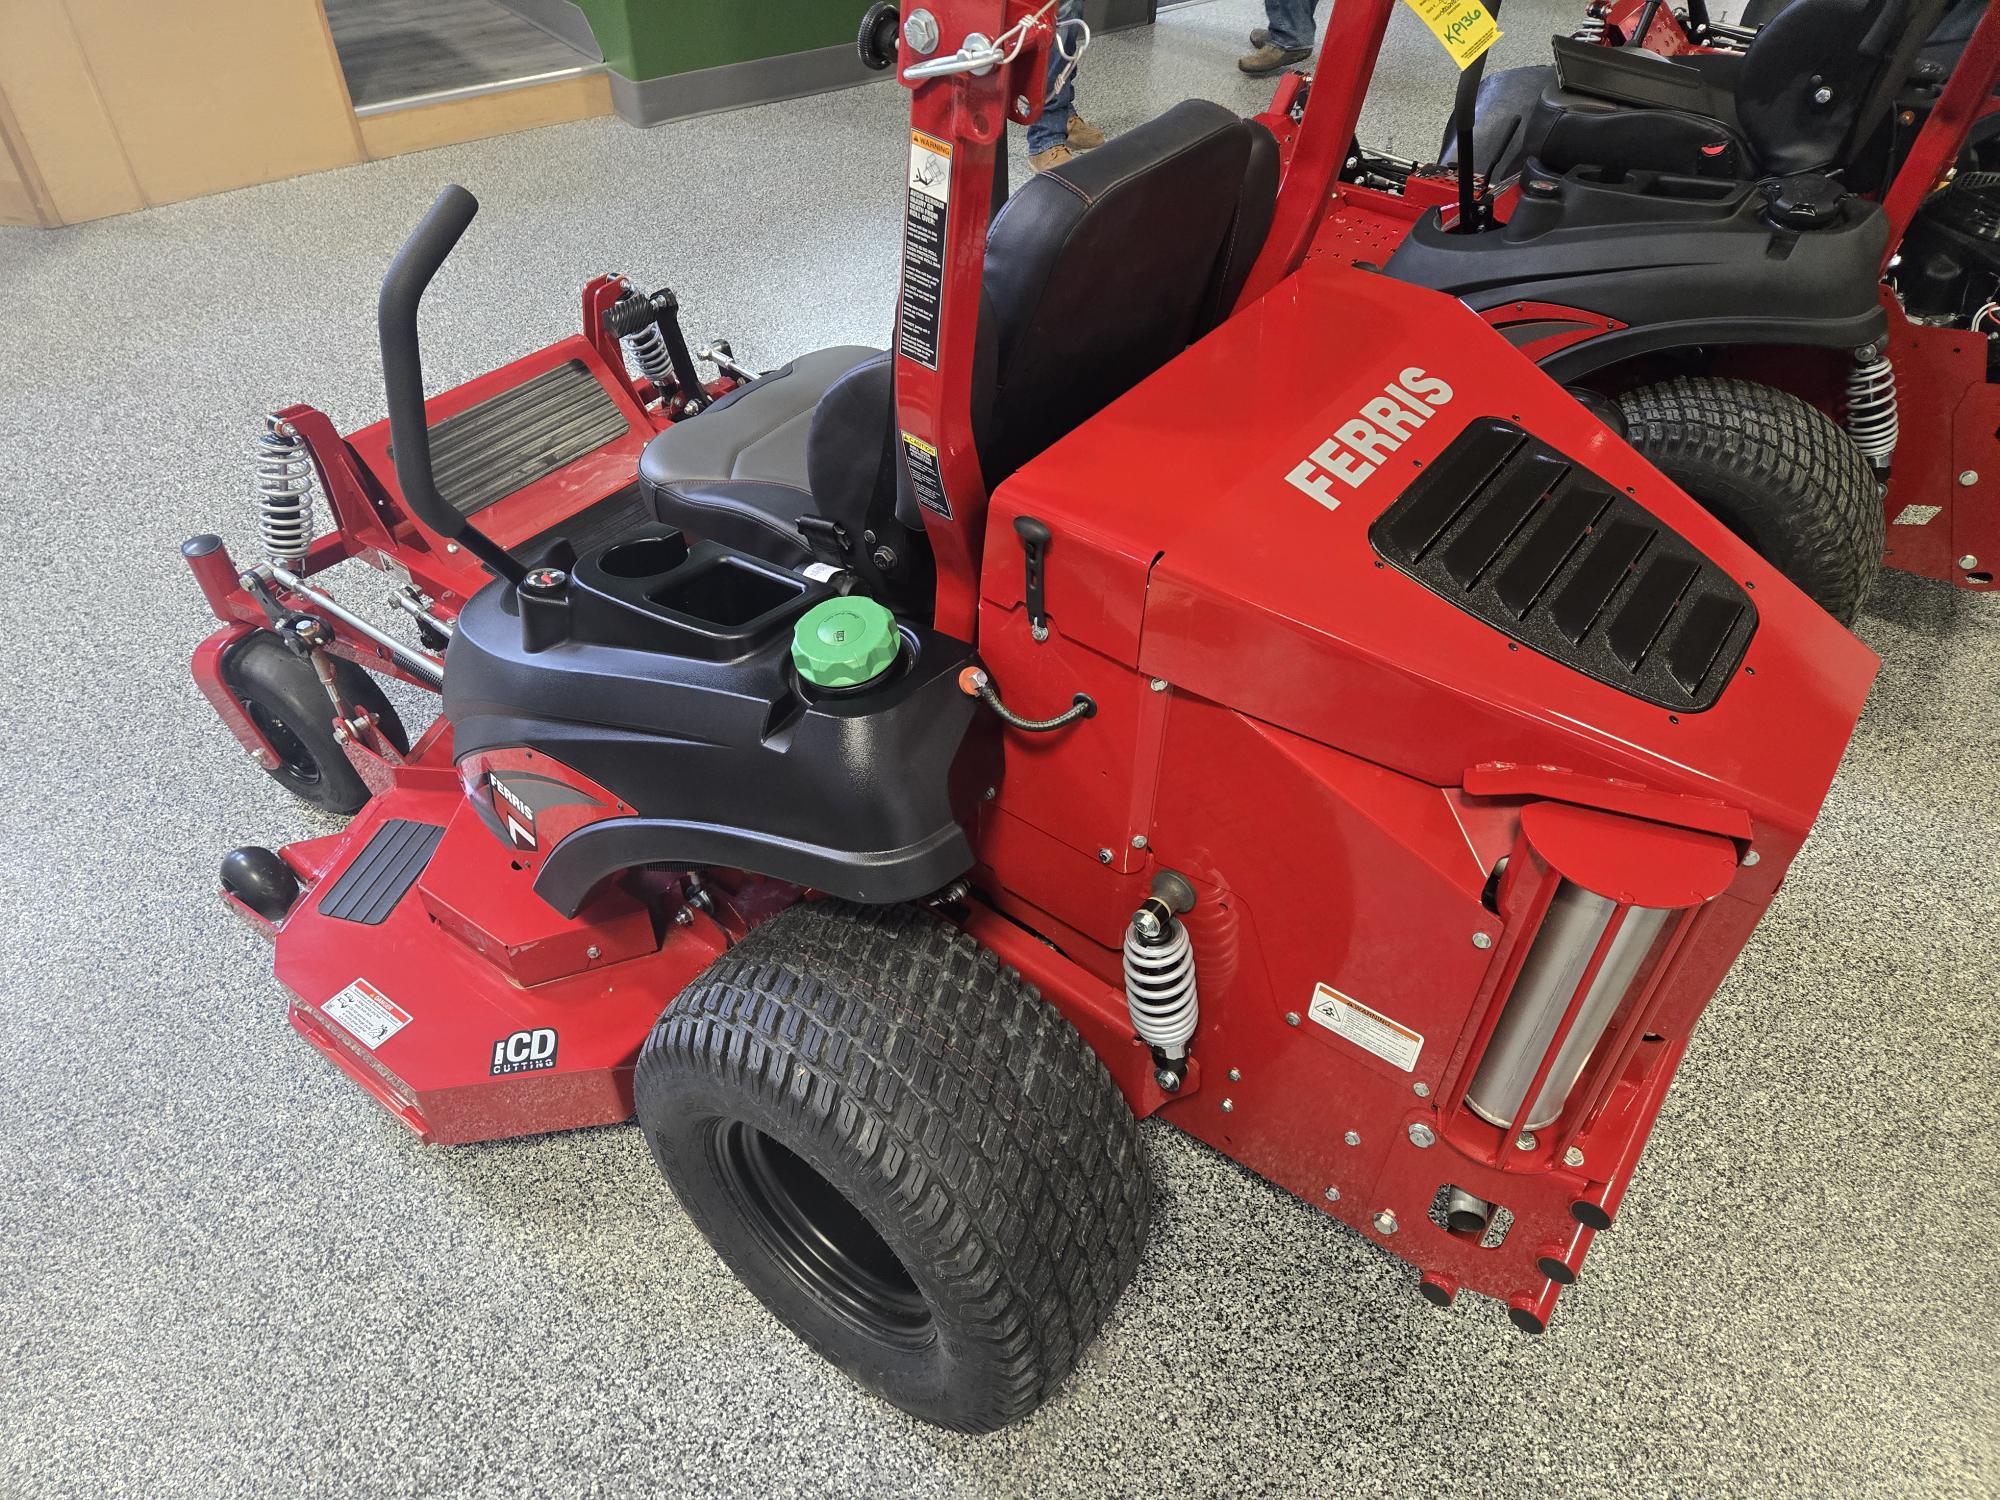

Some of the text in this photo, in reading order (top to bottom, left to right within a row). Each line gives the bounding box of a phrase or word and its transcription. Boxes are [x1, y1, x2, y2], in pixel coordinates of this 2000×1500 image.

[920, 137, 949, 155] WARNING
[1283, 366, 1454, 512] FERRIS
[489, 772, 533, 821] FERRIS
[1352, 1004, 1391, 1027] WARNING
[493, 1058, 554, 1074] CUTTING
